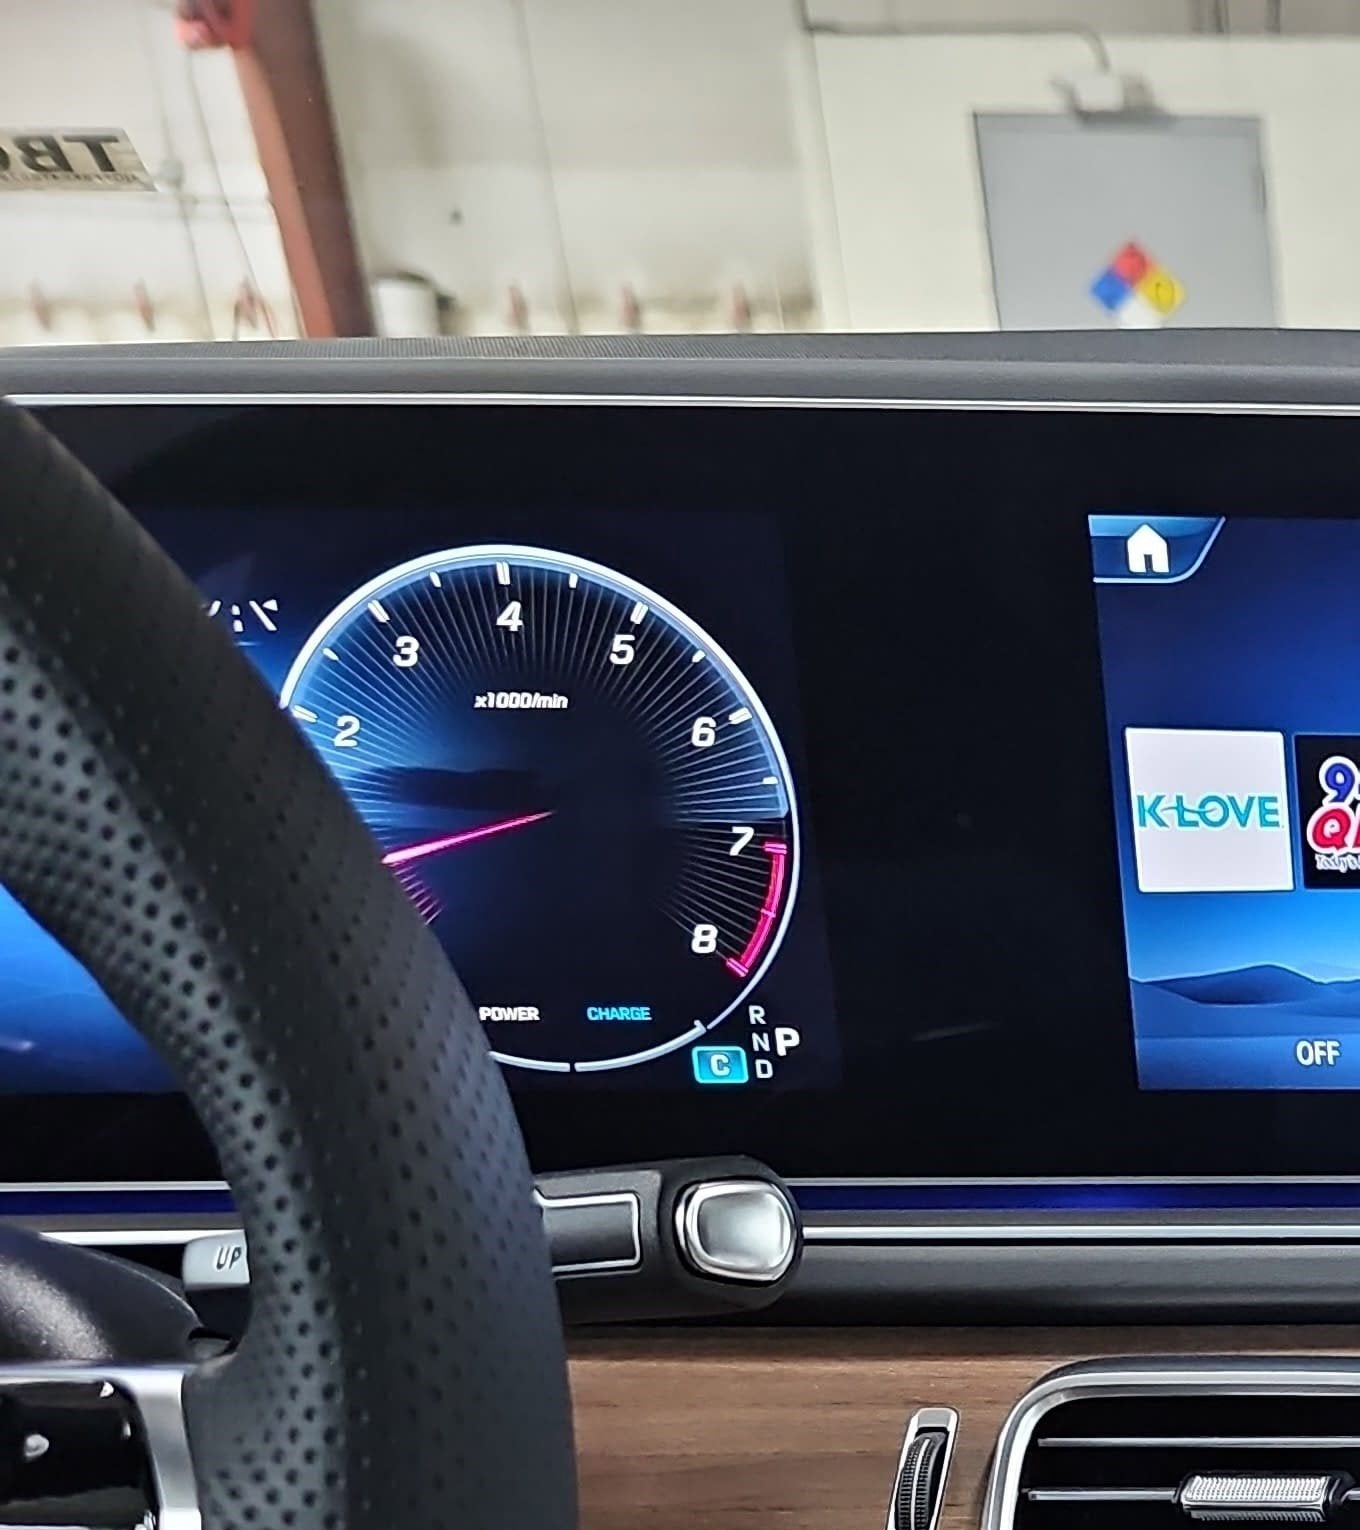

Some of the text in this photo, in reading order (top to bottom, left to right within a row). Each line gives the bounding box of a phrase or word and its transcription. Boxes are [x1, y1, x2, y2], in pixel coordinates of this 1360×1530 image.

[496, 601, 523, 632] 4
[393, 635, 420, 667] 3
[609, 634, 636, 666] 5
[473, 691, 569, 709] x1000/min
[333, 715, 361, 747] 2
[691, 716, 717, 748] 6
[731, 827, 755, 856] 7
[691, 924, 718, 955] 8
[479, 1006, 541, 1021] POWER
[587, 1006, 653, 1021] CHARGE
[748, 1005, 767, 1025] R
[751, 1032, 770, 1052] N
[774, 1027, 800, 1057] P
[1295, 1040, 1341, 1066] OFF
[710, 1053, 731, 1077] C
[755, 1058, 774, 1079] D
[216, 1246, 242, 1270] UP
